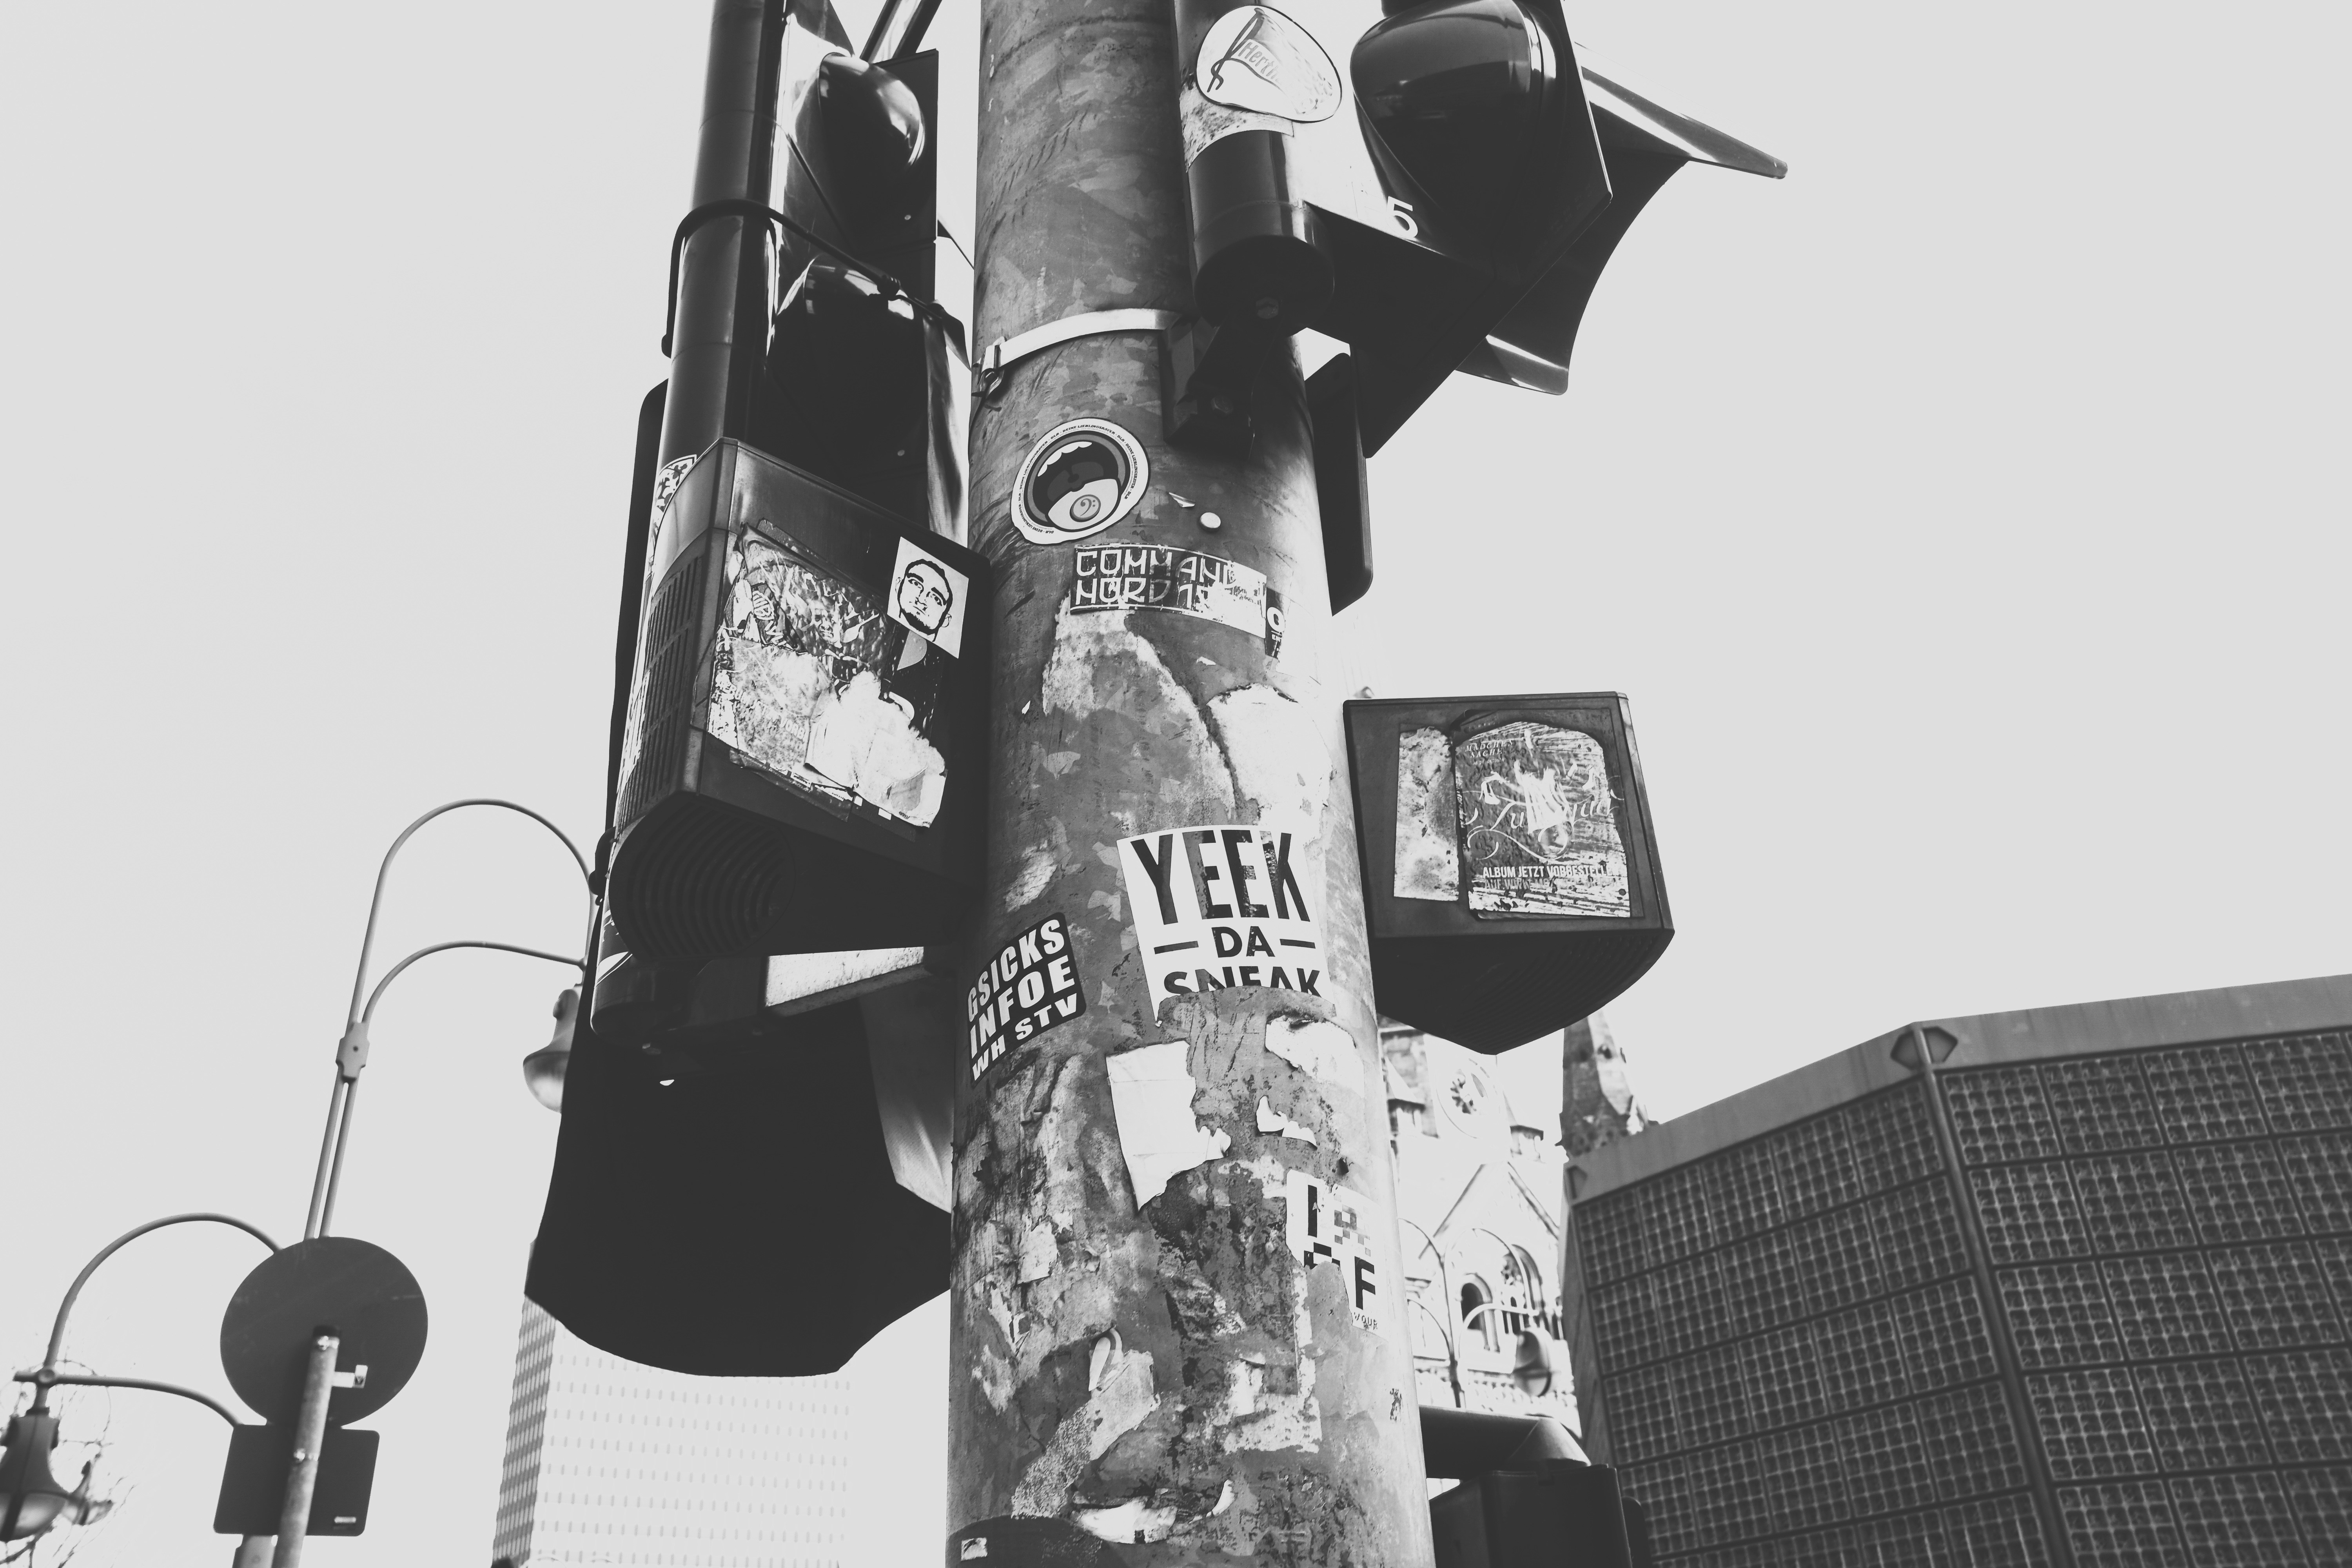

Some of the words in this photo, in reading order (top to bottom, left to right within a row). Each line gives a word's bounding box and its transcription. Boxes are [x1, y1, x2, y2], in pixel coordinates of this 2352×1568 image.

[1130, 829, 1310, 925] YEEK
[1483, 867, 1516, 878] ALBUM
[1518, 866, 1544, 878] JETZT
[967, 919, 1065, 1022] GSICKS
[1211, 926, 1275, 958] DA
[970, 955, 1075, 1059] INFOE
[972, 1036, 1006, 1081] WH
[1015, 993, 1077, 1040] STV
